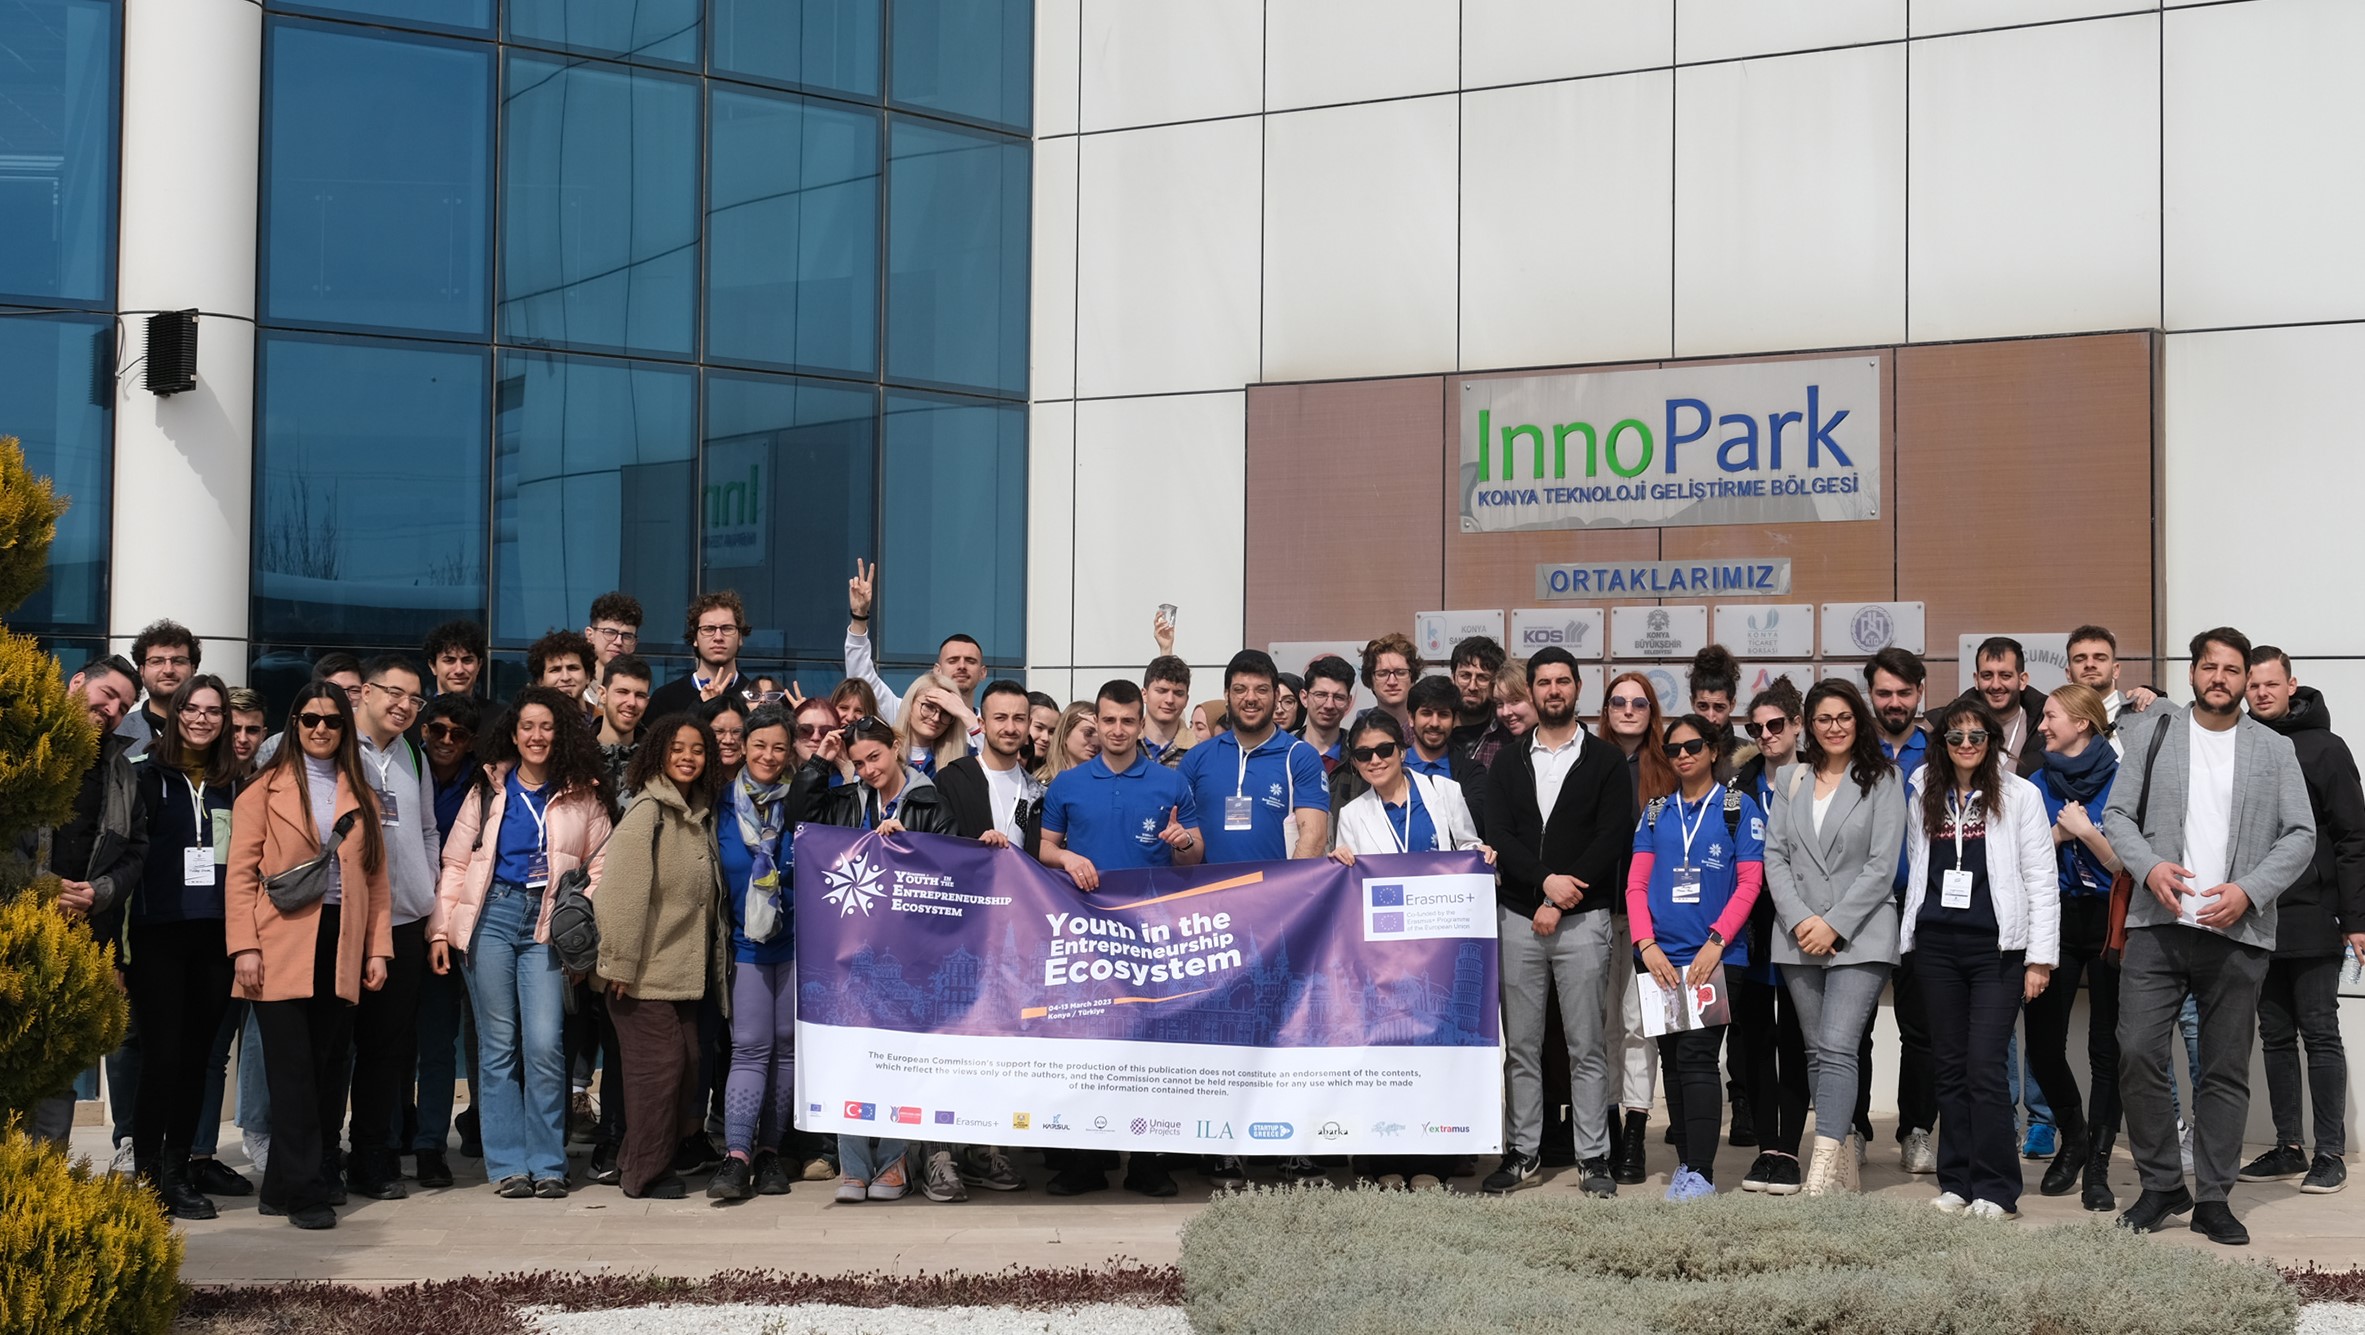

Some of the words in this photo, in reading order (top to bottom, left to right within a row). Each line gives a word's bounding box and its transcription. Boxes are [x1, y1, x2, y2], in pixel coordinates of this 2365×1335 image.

[1478, 385, 1853, 482] InnoPark
[1478, 488, 1539, 507] KONYA
[1543, 484, 1647, 505] TEKNOLOJİ
[1650, 477, 1766, 502] GELİŞTİRME
[1770, 472, 1859, 496] BÖLGESİ
[1550, 564, 1775, 592] ORTAKLARIMIZ
[1461, 625, 1487, 633] KONYA
[1523, 630, 1563, 643] KOS
[1634, 639, 1682, 649] BÜYÜKŞEHİR
[892, 884, 1012, 906] ENTREPRENEURSHIP
[891, 899, 962, 917] ECOSYSTEM
[1406, 910, 1436, 918] Co-funded
[1045, 912, 1136, 941] Youth
[1141, 922, 1170, 944] in
[1179, 911, 1231, 937] the
[1425, 924, 1453, 932] European
[1437, 917, 1470, 925] Programme
[1050, 932, 1234, 960] Entrepreneurship
[1044, 949, 1242, 987] Ecosystem
[1048, 1004, 1069, 1012] 04-13
[1070, 1001, 1092, 1010] March
[1093, 999, 1112, 1007] 2023
[1048, 1011, 1071, 1020] Konya
[1078, 1008, 1105, 1018] Türkiye
[868, 1051, 884, 1061] The
[887, 1053, 929, 1065] European
[932, 1056, 993, 1067] Commission's
[996, 1060, 1031, 1070] support
[1033, 1060, 1047, 1069] for
[1049, 1061, 1064, 1070] the
[1066, 1062, 1116, 1072] production
[1118, 1063, 1128, 1072] of
[1129, 1064, 1146, 1073] this
[1148, 1065, 1197, 1076] publication
[1199, 1067, 1220, 1076] does
[1221, 1068, 1235, 1077] not
[1237, 1069, 1277, 1078] constitute
[1292, 1069, 1351, 1078] endorsement
[1353, 1068, 1363, 1077] of
[1365, 1068, 1379, 1077] the
[1381, 1068, 1421, 1078] contents,
[875, 1062, 901, 1072] which
[903, 1065, 933, 1074] reflect
[935, 1066, 950, 1075] the
[952, 1067, 978, 1076] views
[980, 1068, 1000, 1079] only
[1002, 1068, 1012, 1077] of
[1014, 1069, 1029, 1078] the
[1031, 1070, 1068, 1081] authors,
[1070, 1071, 1087, 1080] and
[1089, 1072, 1104, 1081] the
[1107, 1073, 1160, 1084] Commission
[1162, 1076, 1192, 1085] cannot
[1194, 1077, 1205, 1086] be
[1207, 1077, 1226, 1086] held
[1228, 1078, 1273, 1089] responsible
[1276, 1079, 1289, 1088] for
[1291, 1080, 1307, 1090] any
[1309, 1080, 1325, 1088] use
[1327, 1079, 1353, 1088] which
[1355, 1079, 1374, 1089] may
[1376, 1078, 1387, 1087] be
[1389, 1078, 1413, 1087] made
[1068, 1082, 1078, 1091] of
[1080, 1082, 1095, 1091] the
[1097, 1083, 1149, 1093] information
[1151, 1085, 1195, 1095] contained
[1197, 1087, 1229, 1097] therein.
[1149, 1119, 1181, 1130] Unique
[1196, 1120, 1234, 1139] ILA
[1317, 1127, 1349, 1135] abarka
[1429, 1125, 1470, 1133] extramus
[1150, 1127, 1181, 1137] Projects
